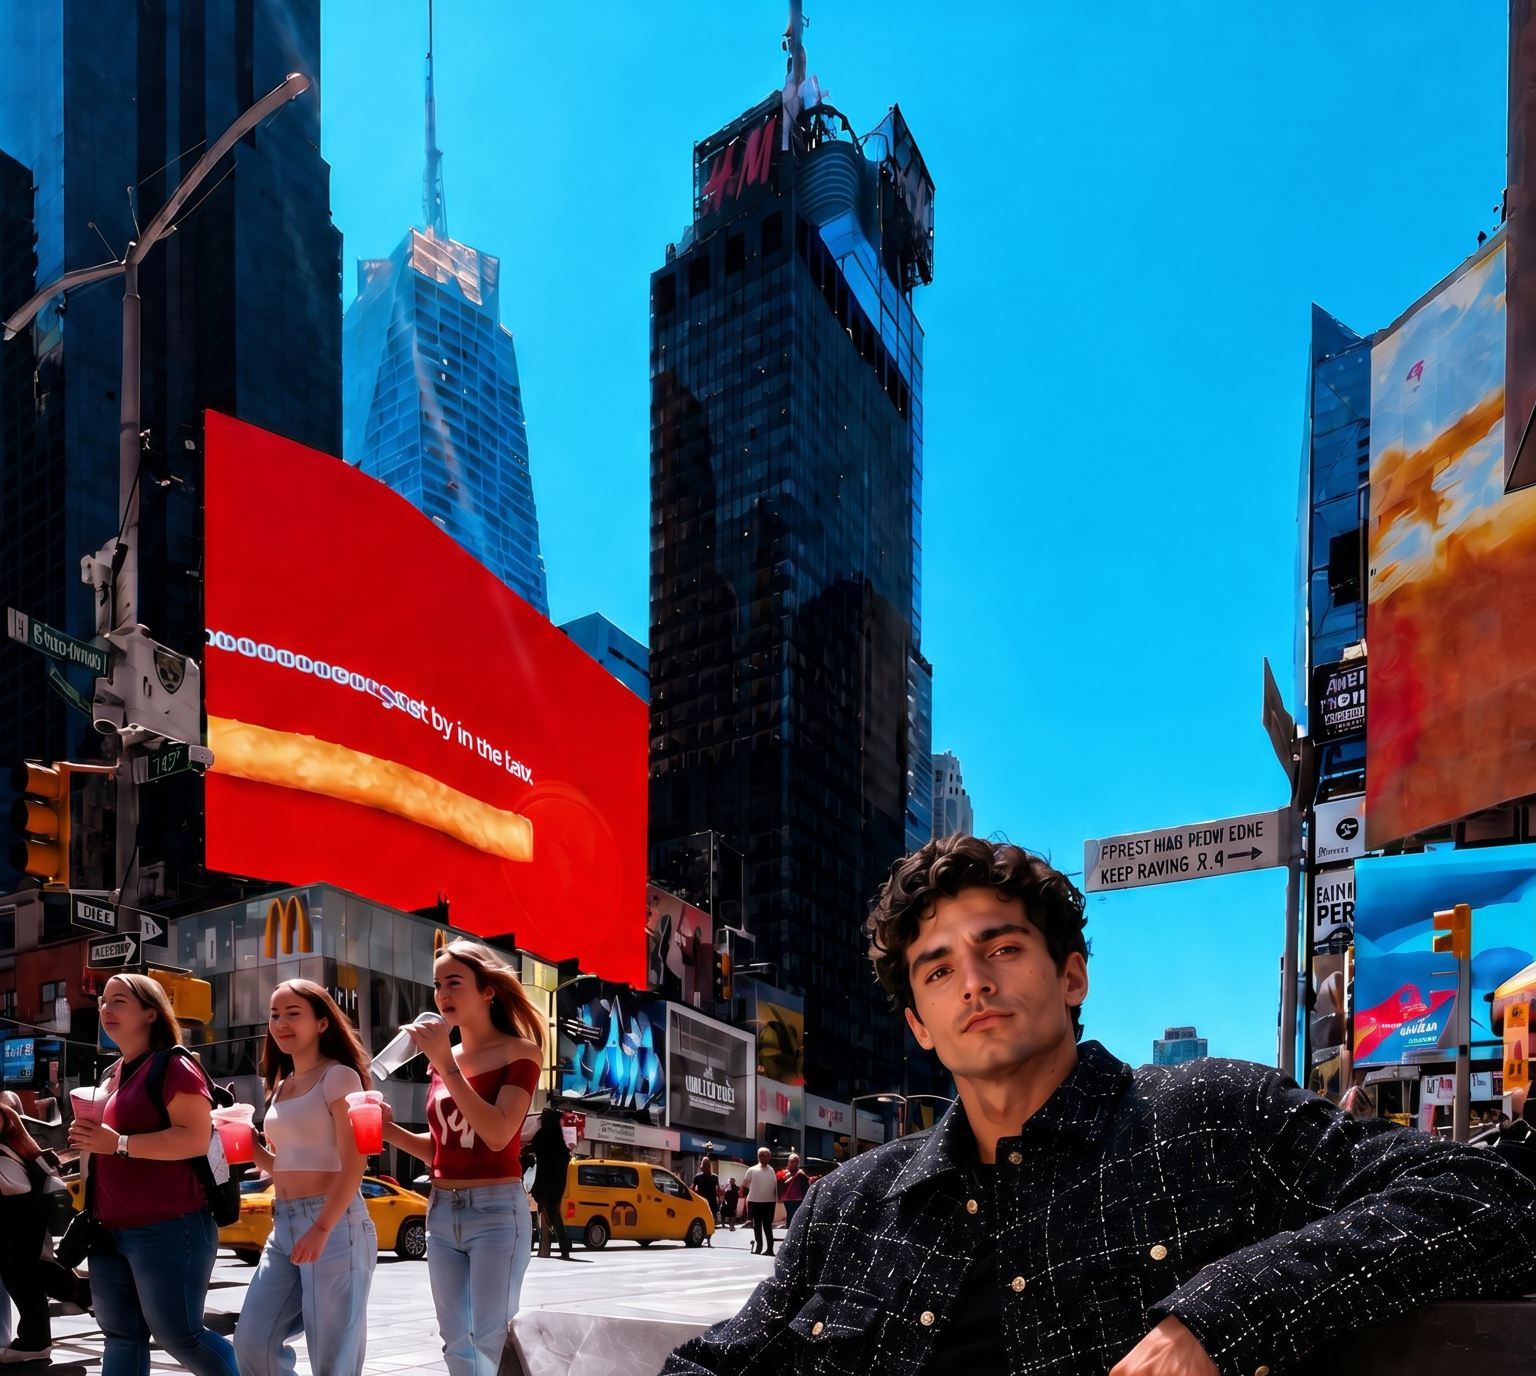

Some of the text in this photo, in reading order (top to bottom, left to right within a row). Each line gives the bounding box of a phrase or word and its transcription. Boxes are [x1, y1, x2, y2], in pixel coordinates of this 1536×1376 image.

[431, 706, 453, 740] by
[457, 721, 473, 750] in
[476, 737, 502, 766] the
[1101, 866, 1134, 885] KEEP
[1137, 856, 1190, 880] RAVING
